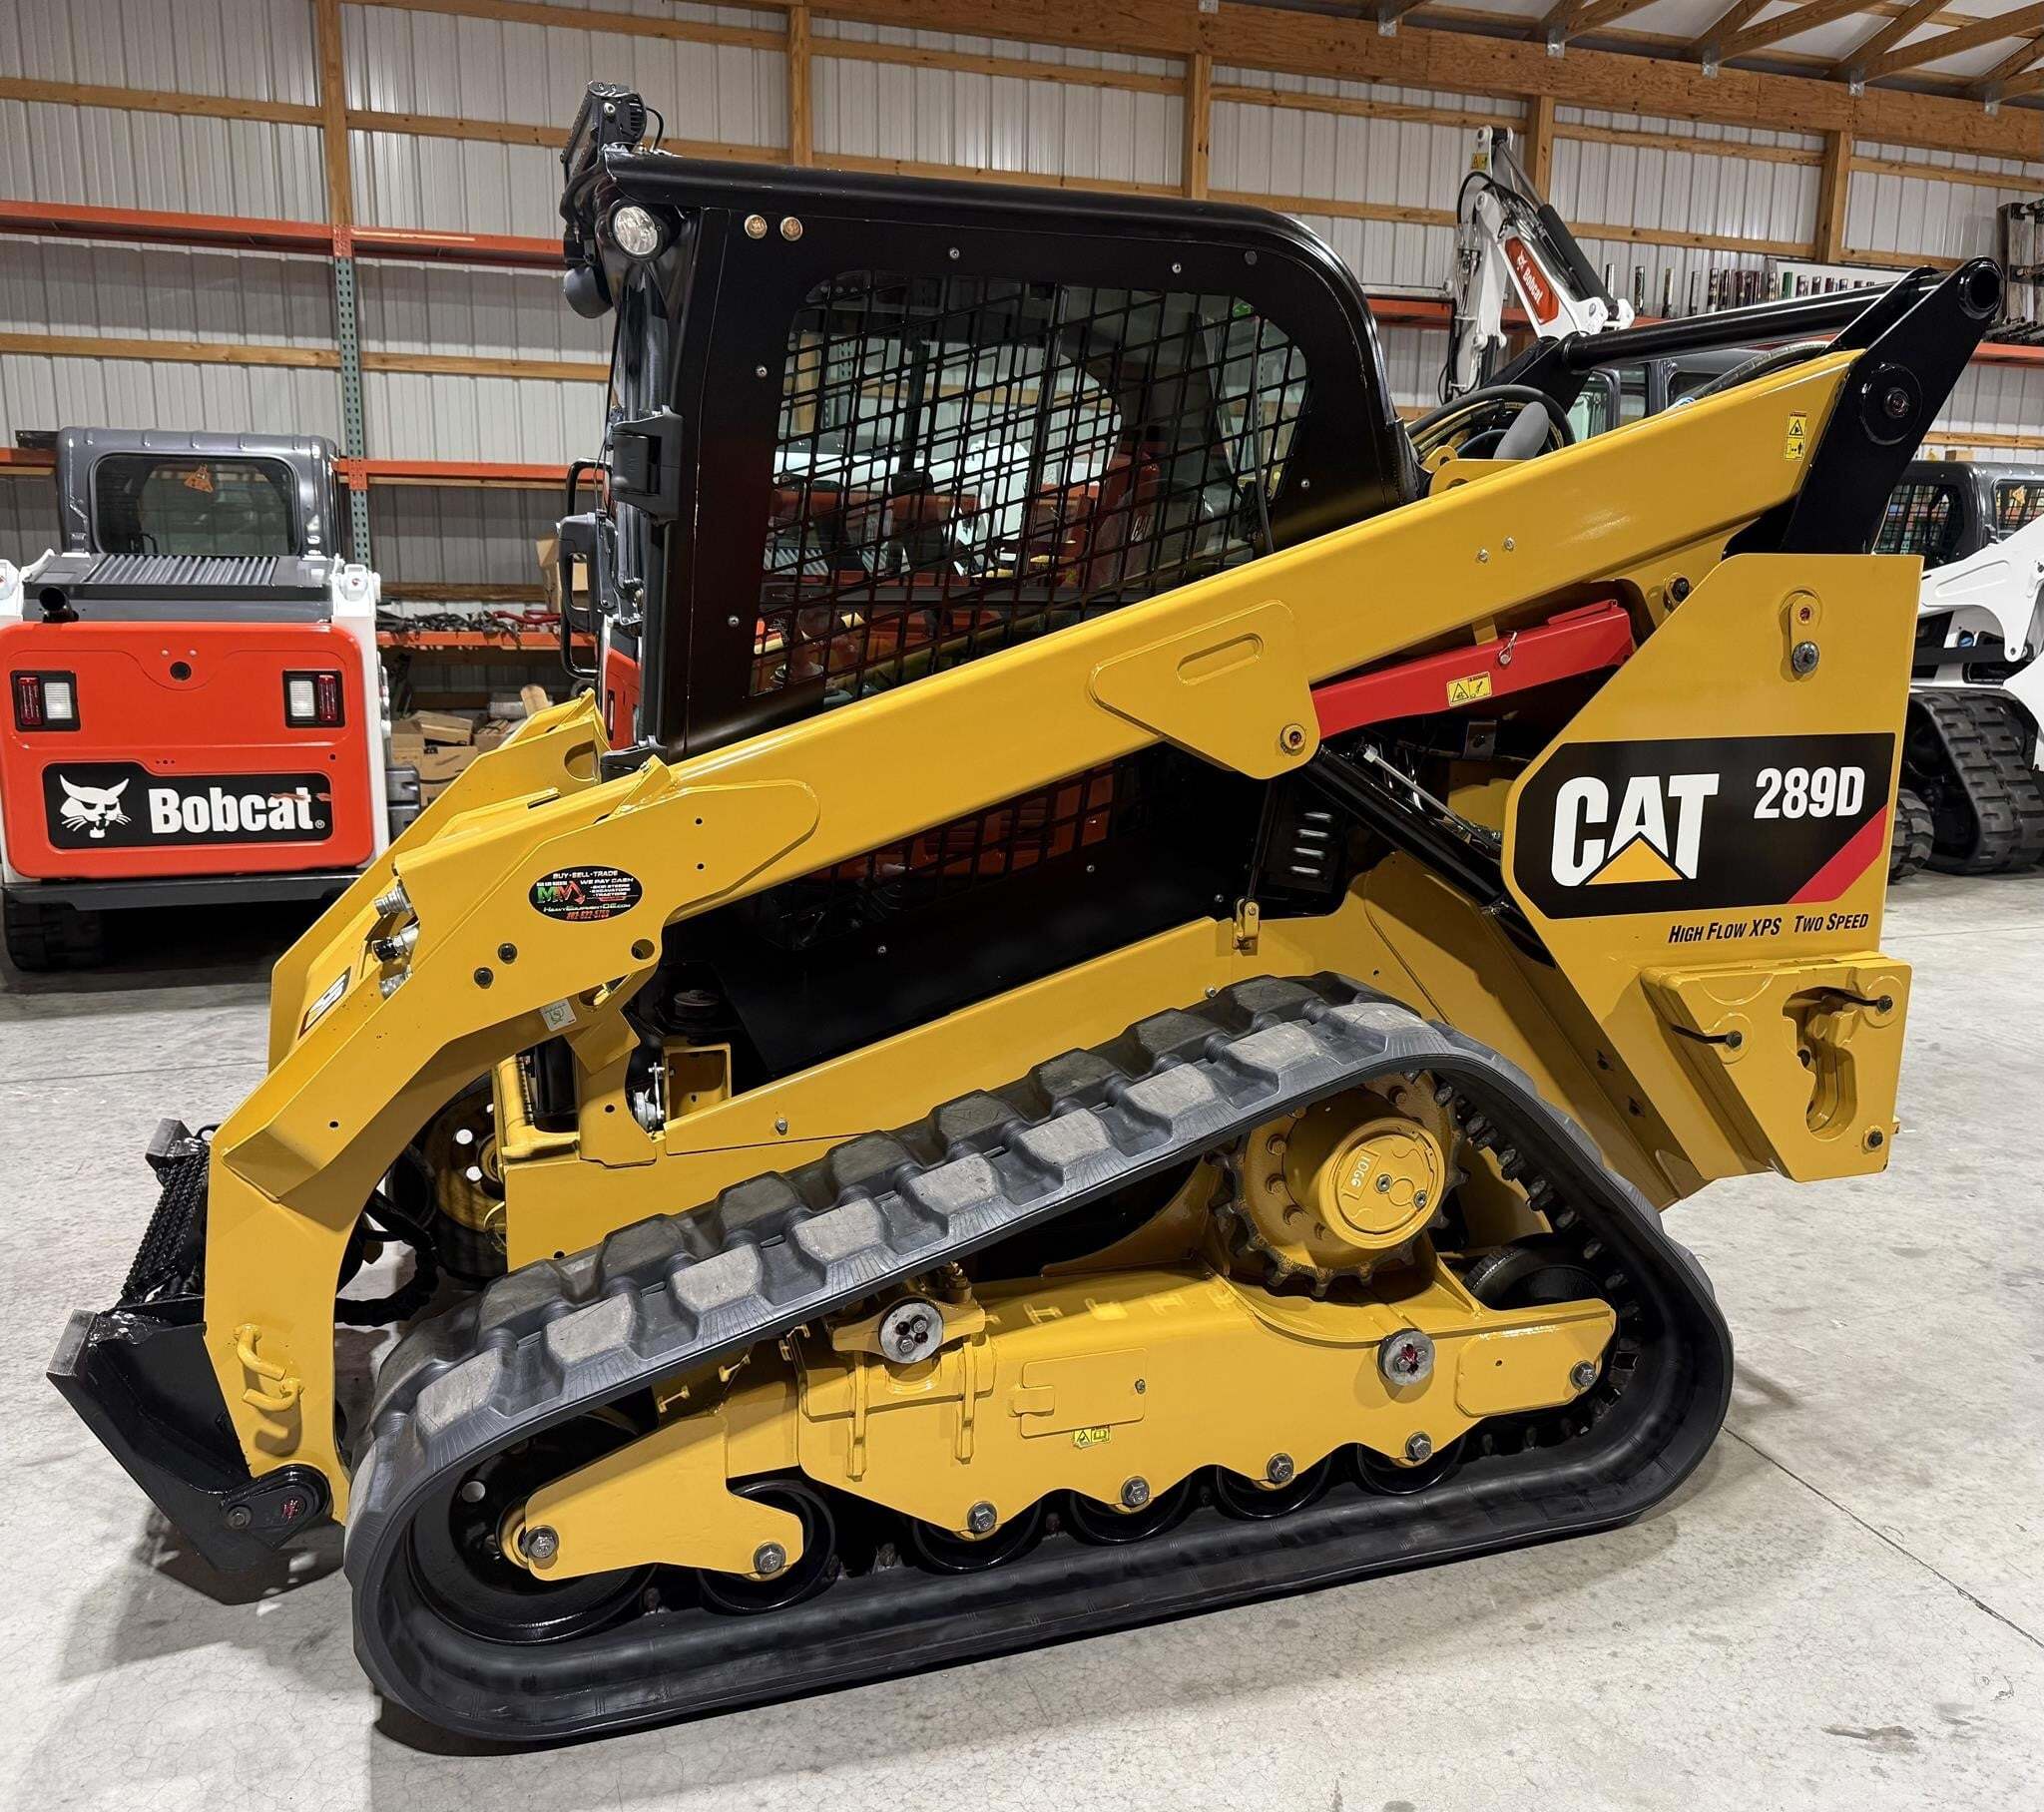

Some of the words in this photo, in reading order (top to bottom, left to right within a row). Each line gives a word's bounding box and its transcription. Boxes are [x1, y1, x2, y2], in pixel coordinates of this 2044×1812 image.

[1522, 266, 1544, 304] Bobcat
[1551, 773, 1720, 887] CAT
[1754, 766, 1866, 820] 289D
[1749, 917, 1783, 937] XPS
